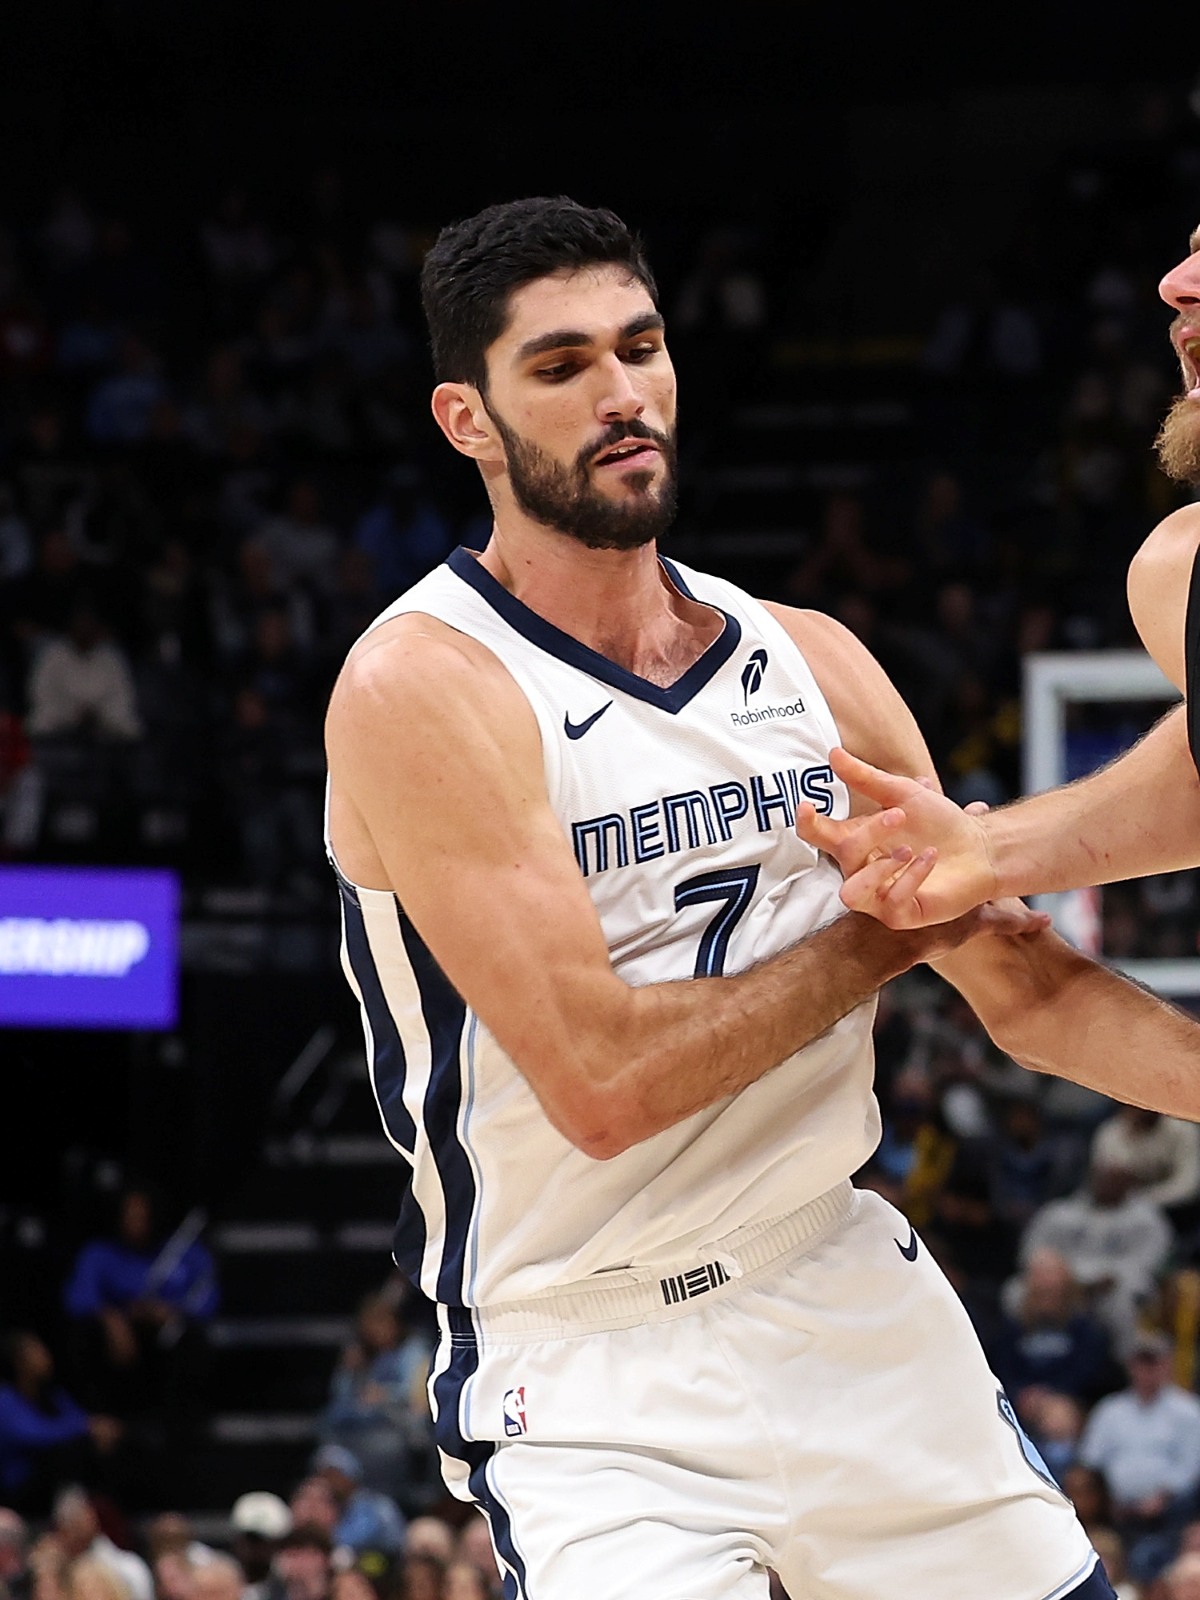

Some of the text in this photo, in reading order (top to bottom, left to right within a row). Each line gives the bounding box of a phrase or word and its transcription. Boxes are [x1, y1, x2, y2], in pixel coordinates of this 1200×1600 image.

[730, 697, 806, 728] Robinhood
[571, 764, 835, 878] MEMPHIS
[674, 863, 762, 980] 7
